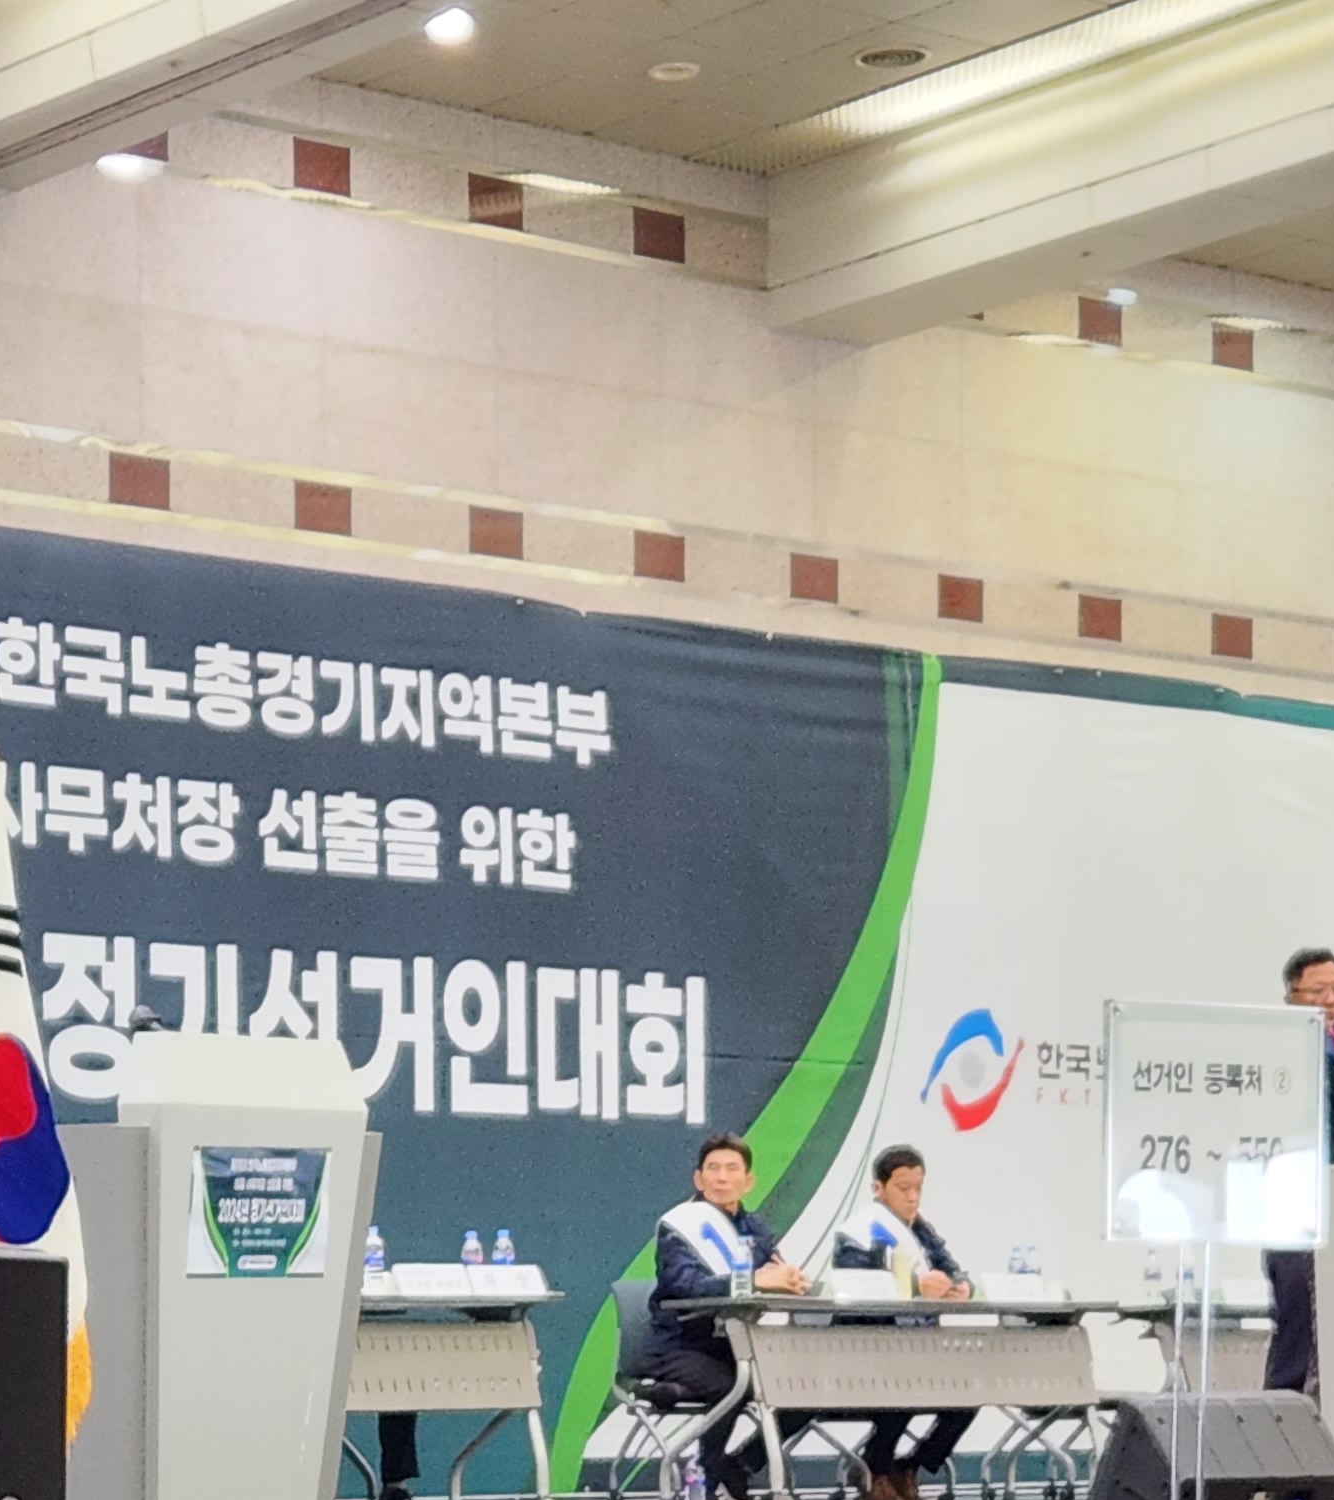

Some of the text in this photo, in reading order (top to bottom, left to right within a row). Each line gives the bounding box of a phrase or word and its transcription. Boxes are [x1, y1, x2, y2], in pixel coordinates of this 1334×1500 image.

[259, 787, 441, 881] 선출을
[460, 803, 577, 892] 위한
[1132, 1060, 1194, 1093] 선거인
[1203, 1062, 1263, 1096] 등록처
[1139, 1134, 1191, 1174] 276
